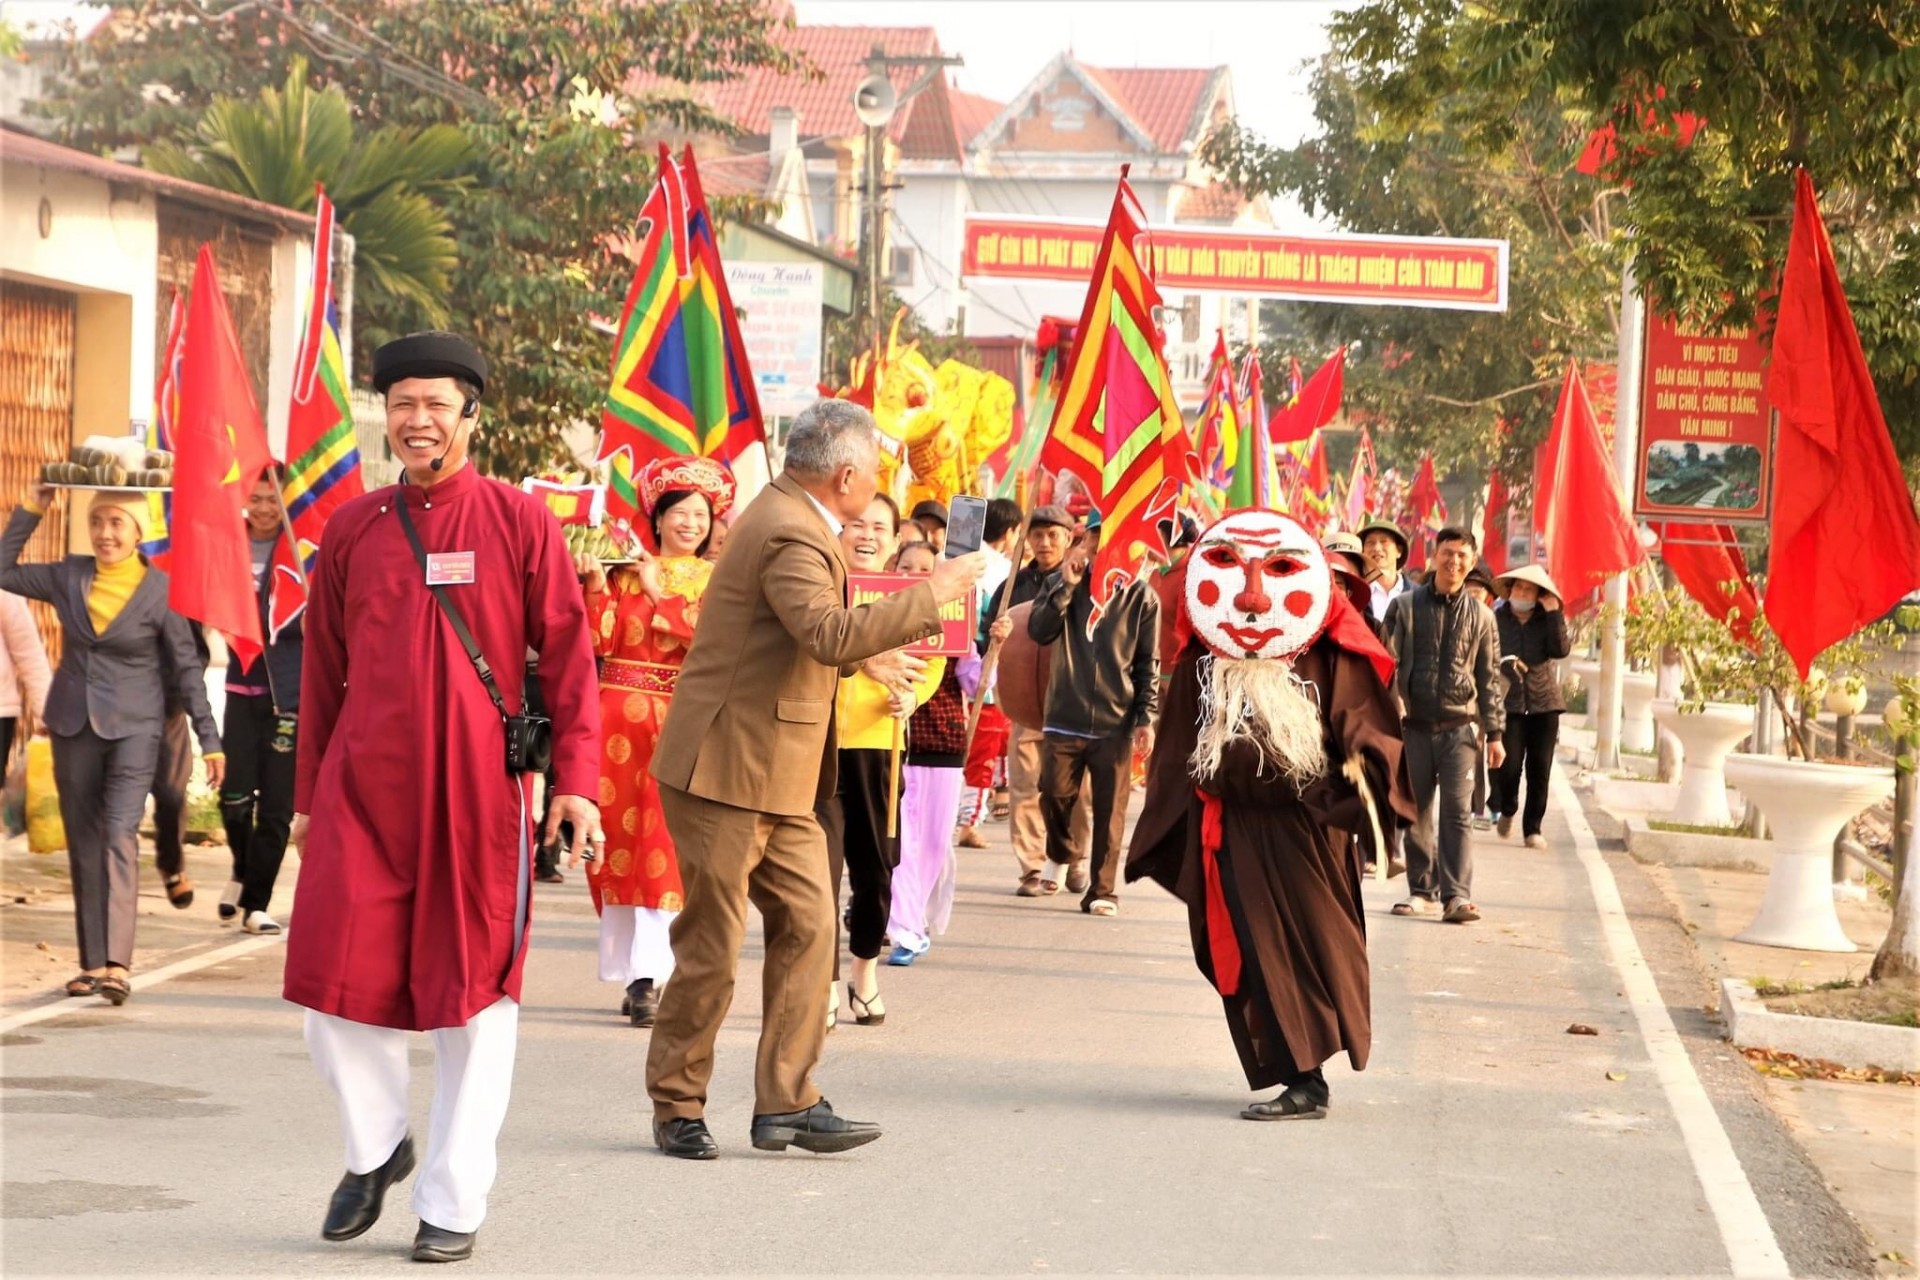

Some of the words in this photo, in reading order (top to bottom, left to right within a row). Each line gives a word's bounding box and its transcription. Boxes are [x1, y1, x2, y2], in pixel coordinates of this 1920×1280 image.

[1022, 234, 1038, 266] VÀ
[1040, 235, 1070, 268] PHÁT
[1071, 239, 1096, 269] HUY
[1218, 242, 1261, 279] TRUYỀN
[1262, 244, 1301, 281] THỐNG
[1303, 250, 1317, 283] LÀ
[1319, 251, 1358, 284] TRÁCH
[1359, 253, 1396, 291] NHIỆM
[1397, 252, 1423, 287] CỦA
[1424, 256, 1455, 289] TOÀN
[1682, 341, 1692, 362] VÌ
[1694, 344, 1716, 366] MỤC
[1718, 342, 1738, 364] TIÊU
[1655, 364, 1676, 386] DÂN
[1677, 366, 1702, 389] GIÀU,
[1704, 367, 1730, 388] NƯỚC
[1732, 371, 1763, 392] MẠNH,
[1656, 389, 1677, 411] DÂN
[1678, 389, 1700, 413] CHỦ,
[1702, 391, 1728, 413] CÔNG
[1730, 389, 1759, 416] BẰNG,
[1680, 415, 1699, 436] VĂN
[1701, 418, 1727, 437] MINH
